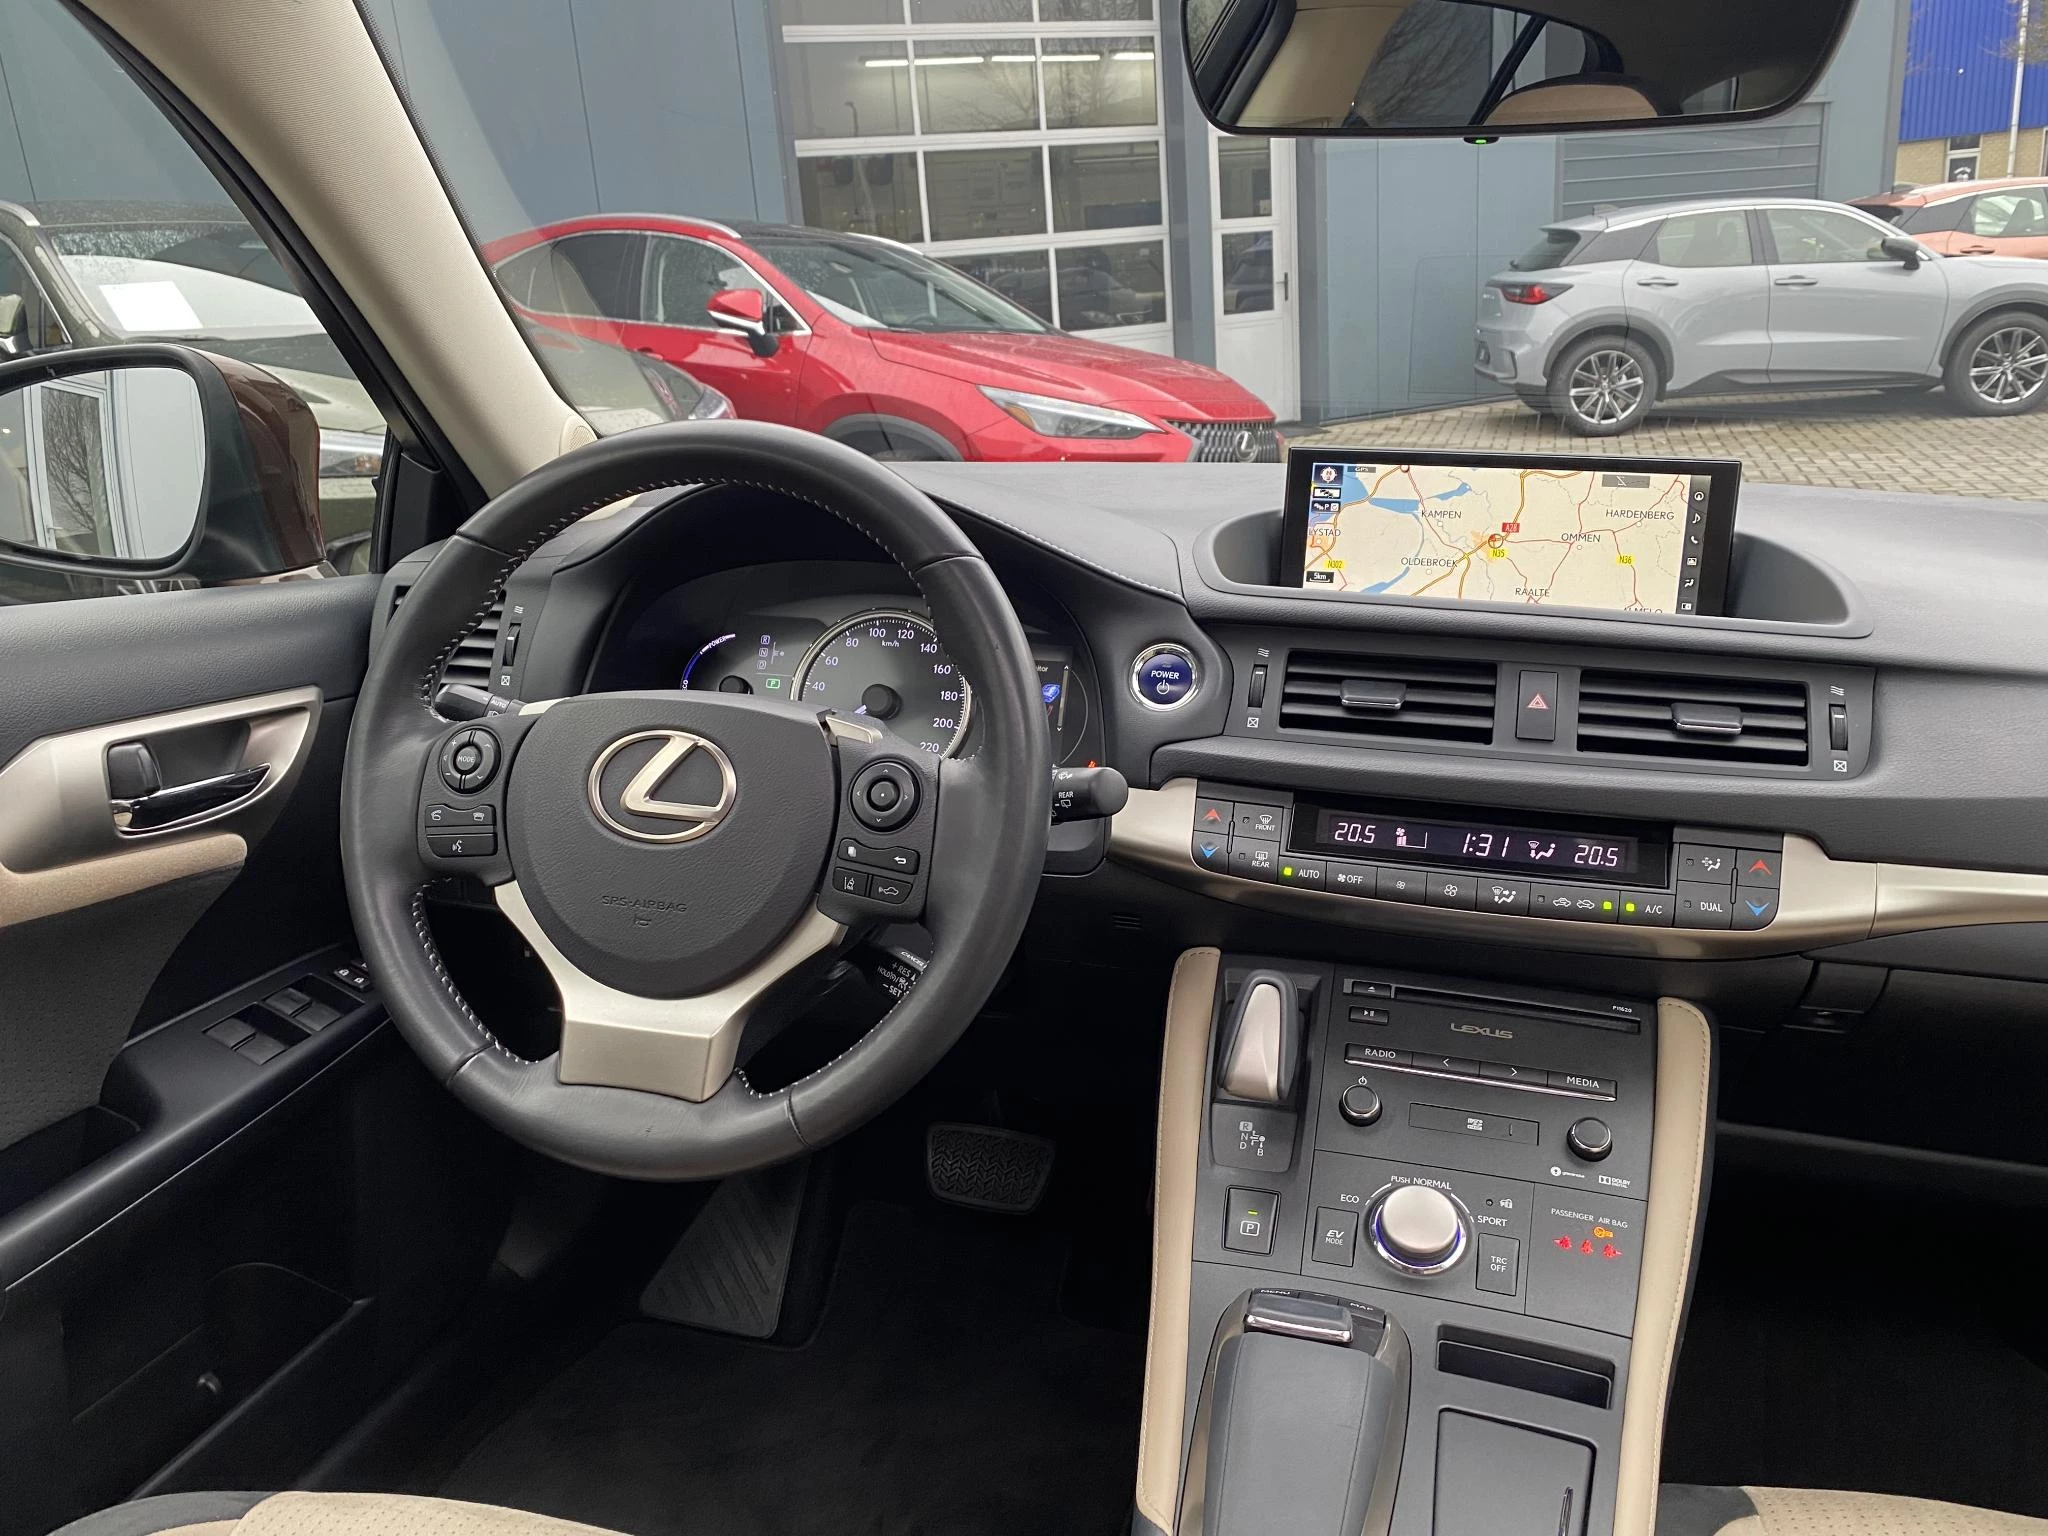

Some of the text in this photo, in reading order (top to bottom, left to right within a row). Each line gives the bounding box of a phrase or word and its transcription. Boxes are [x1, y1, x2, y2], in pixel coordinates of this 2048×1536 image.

[1421, 510, 1462, 519] KAMPEN
[1605, 509, 1675, 520] HARDENBERG
[1505, 523, 1518, 532] A28
[1561, 533, 1601, 542] OMMEN
[1492, 549, 1505, 558] N35
[1400, 557, 1458, 568] OLDEBROEK
[1619, 556, 1632, 564] N36
[1313, 572, 1327, 580] 5km
[1515, 587, 1550, 597] RAALTE
[869, 628, 886, 638] 100
[897, 630, 915, 640] 120
[845, 638, 859, 648] 80
[881, 640, 900, 648] km/h
[920, 643, 938, 654] 140
[825, 657, 839, 666] 60
[933, 665, 951, 675] 160
[1151, 670, 1180, 680] POWER
[812, 682, 826, 691] 40
[940, 691, 958, 701] 180
[933, 718, 954, 728] 200
[920, 743, 940, 753] 220
[457, 755, 477, 764] MODE
[1058, 791, 1074, 799] REAR
[1255, 823, 1276, 832] FRONT
[1334, 822, 1376, 844] 20.5
[1462, 833, 1510, 857] 1:31
[1574, 844, 1619, 867] 20.5
[1252, 860, 1270, 868] REAR
[1298, 869, 1320, 879] AUTO
[1346, 874, 1363, 885] OFF
[1645, 904, 1663, 915] A/C
[1700, 902, 1723, 912] DUAL
[1450, 1022, 1513, 1039] LEXUS
[1364, 1048, 1396, 1059] RADIO
[1566, 1075, 1600, 1089] MEDIA
[1239, 1141, 1247, 1149] D
[1257, 1149, 1264, 1157] B
[1390, 1175, 1452, 1189] PUSH NORMAL
[1340, 1193, 1360, 1203] ECO
[1551, 1207, 1594, 1221] PASSENGER
[1477, 1215, 1508, 1227] SPORT
[1326, 1230, 1345, 1238] EV
[1325, 1237, 1344, 1246] MODE
[1490, 1256, 1508, 1264] TRC
[1490, 1264, 1507, 1273] OFF
[1349, 1302, 1375, 1311] MAP
